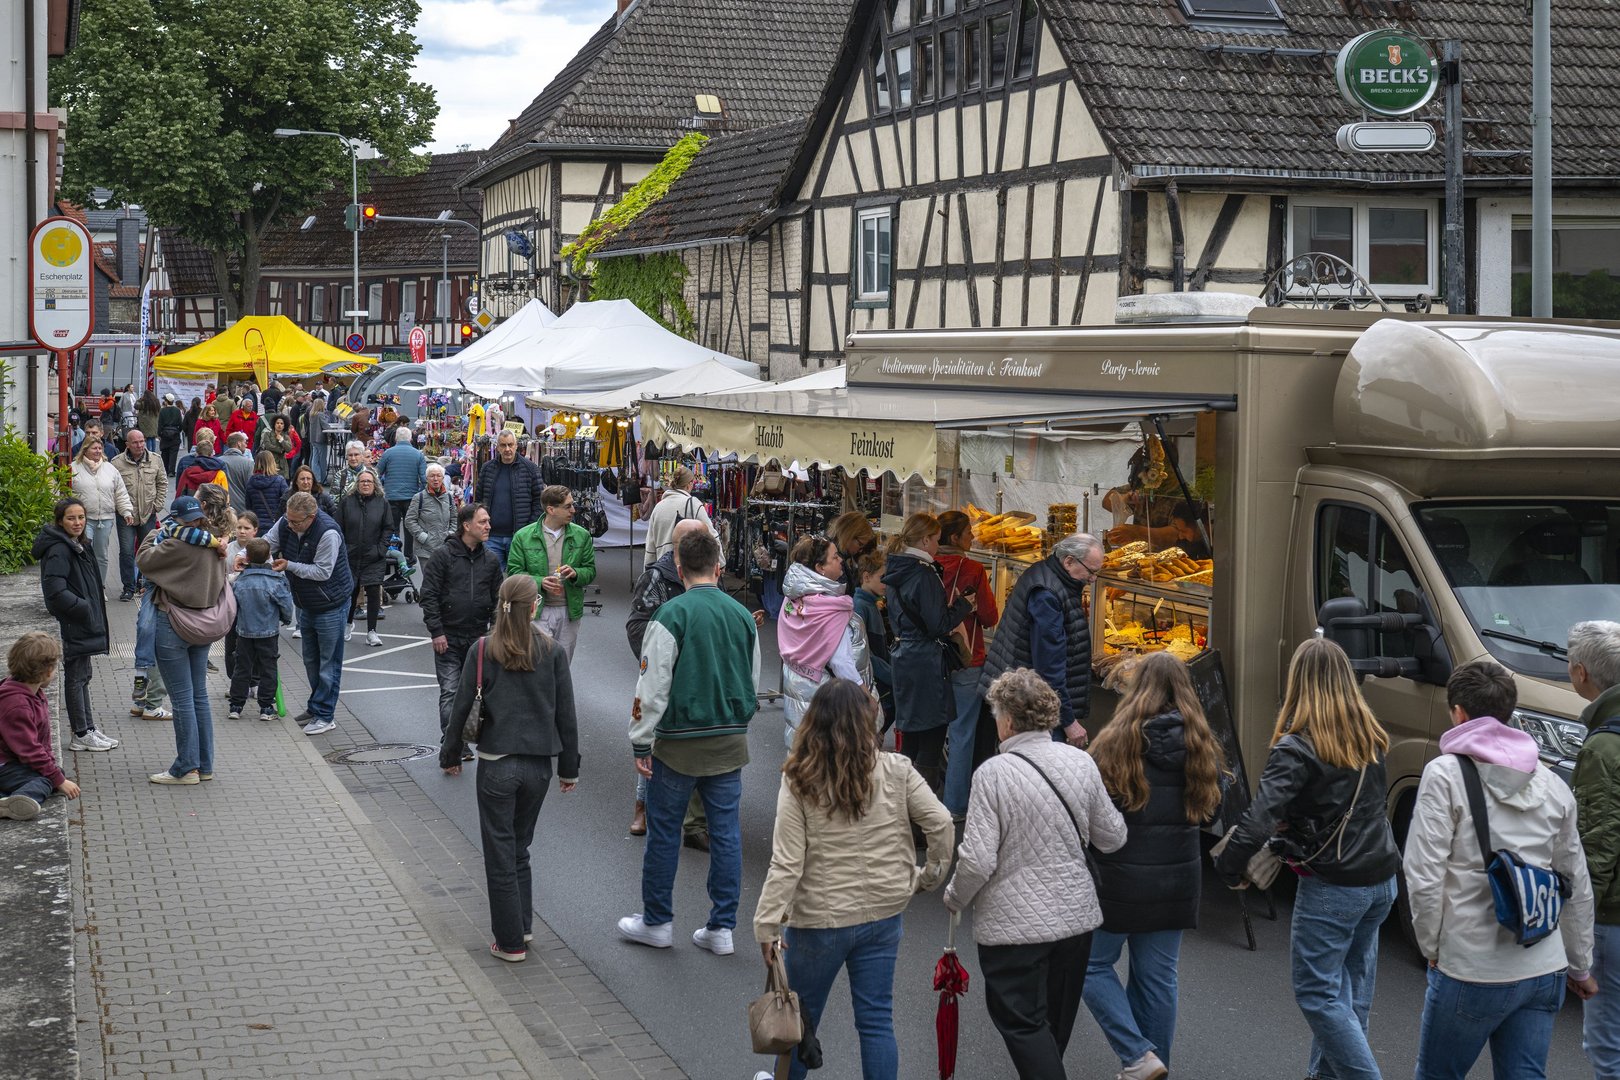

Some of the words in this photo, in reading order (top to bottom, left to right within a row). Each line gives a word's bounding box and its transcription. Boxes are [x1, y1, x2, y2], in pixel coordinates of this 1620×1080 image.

[1360, 66, 1429, 84] BECK'S
[40, 273, 83, 281] Eschenplatz
[877, 355, 927, 374] Mediterrane
[928, 355, 984, 381] Spezialitäten
[987, 361, 996, 376] &
[1000, 357, 1044, 377] Feinkost
[691, 418, 704, 438] Bar
[757, 425, 784, 449] Habib
[850, 432, 895, 459] Feinkost
